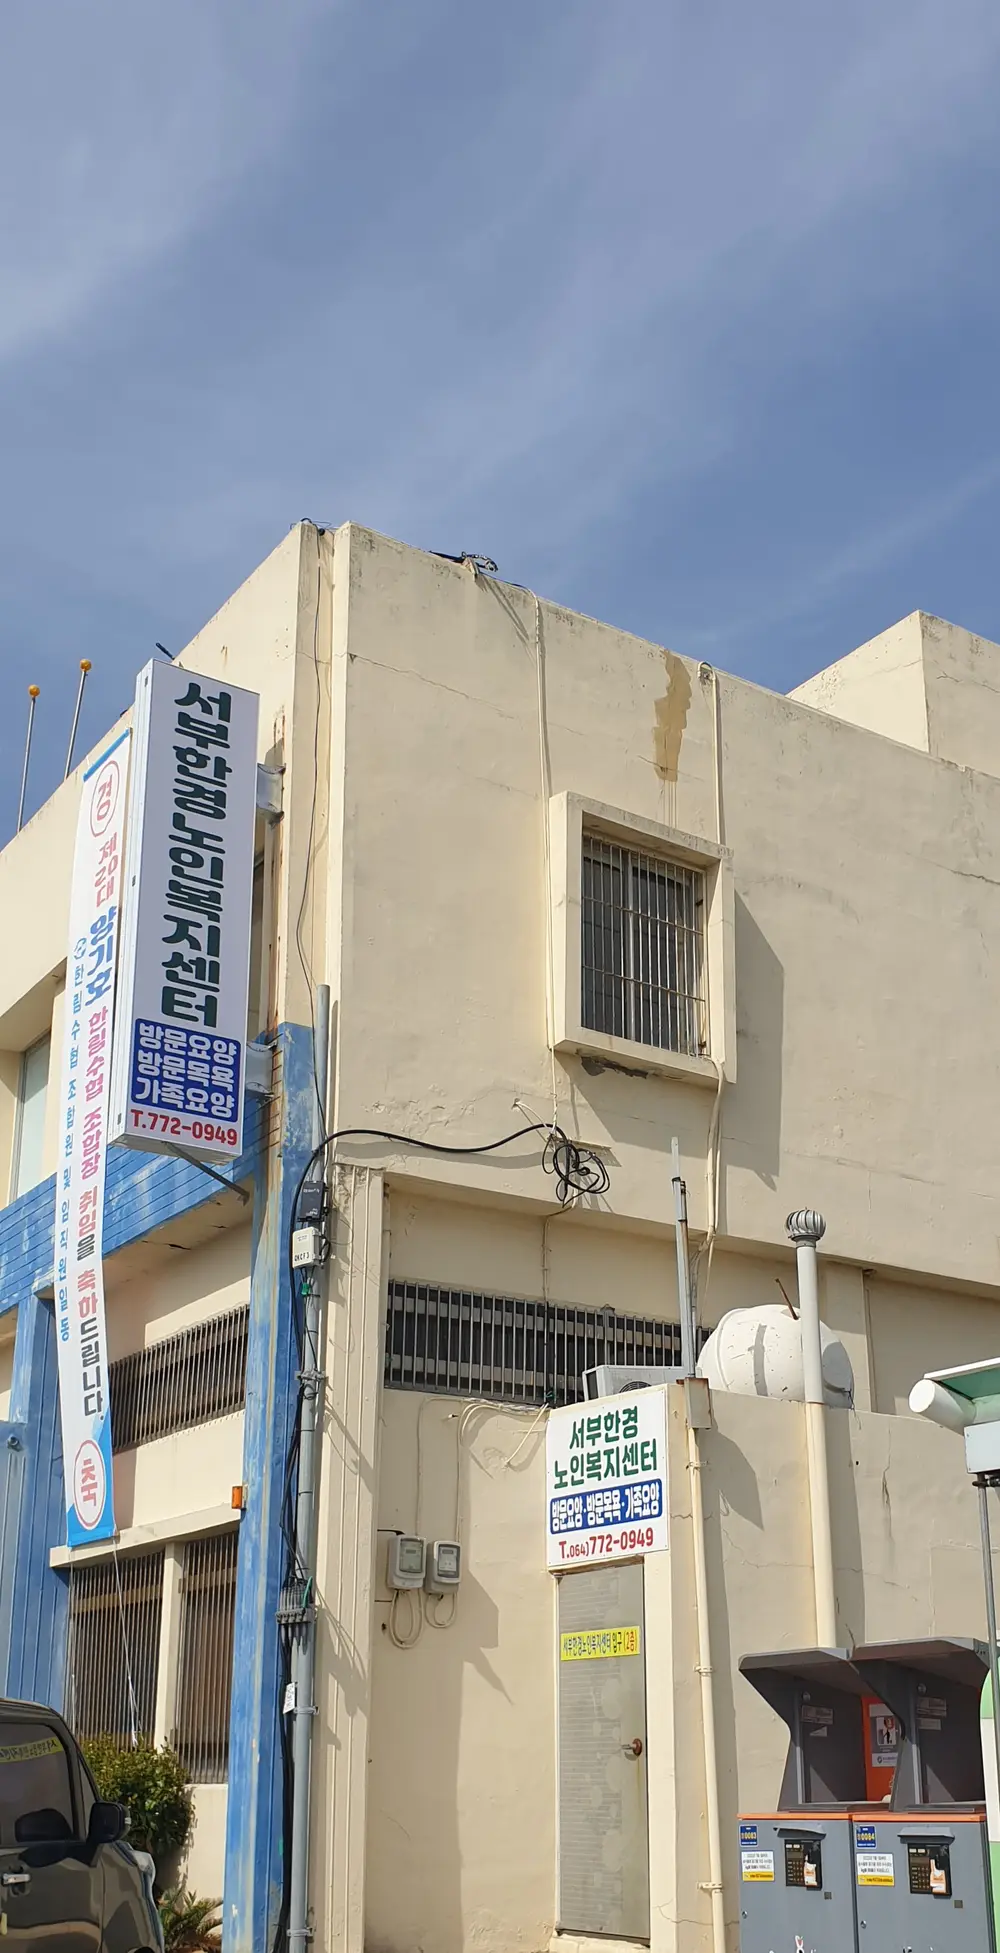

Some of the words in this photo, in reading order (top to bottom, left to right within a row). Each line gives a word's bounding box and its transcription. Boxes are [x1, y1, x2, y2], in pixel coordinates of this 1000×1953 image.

[96, 773, 114, 822] 경
[161, 682, 232, 1028] 서부한경노인복지센터
[84, 905, 118, 1007] 양기호
[69, 963, 84, 1070] 한림수협
[138, 1022, 238, 1066] 방문요양
[84, 1005, 109, 1102] 한림수협
[137, 1049, 235, 1093] 방문목욕
[64, 1078, 78, 1158] 조합원
[135, 1076, 236, 1119] 가족요양
[81, 1106, 102, 1180] 조합장
[130, 1108, 238, 1146] T.772-0949
[63, 1166, 72, 1191] 및
[58, 1199, 70, 1282] 임직원
[77, 1185, 99, 1262] 취임을
[58, 1286, 71, 1343] 일동
[569, 1405, 639, 1450] 서부한경
[553, 1438, 658, 1490] 노인복지센터
